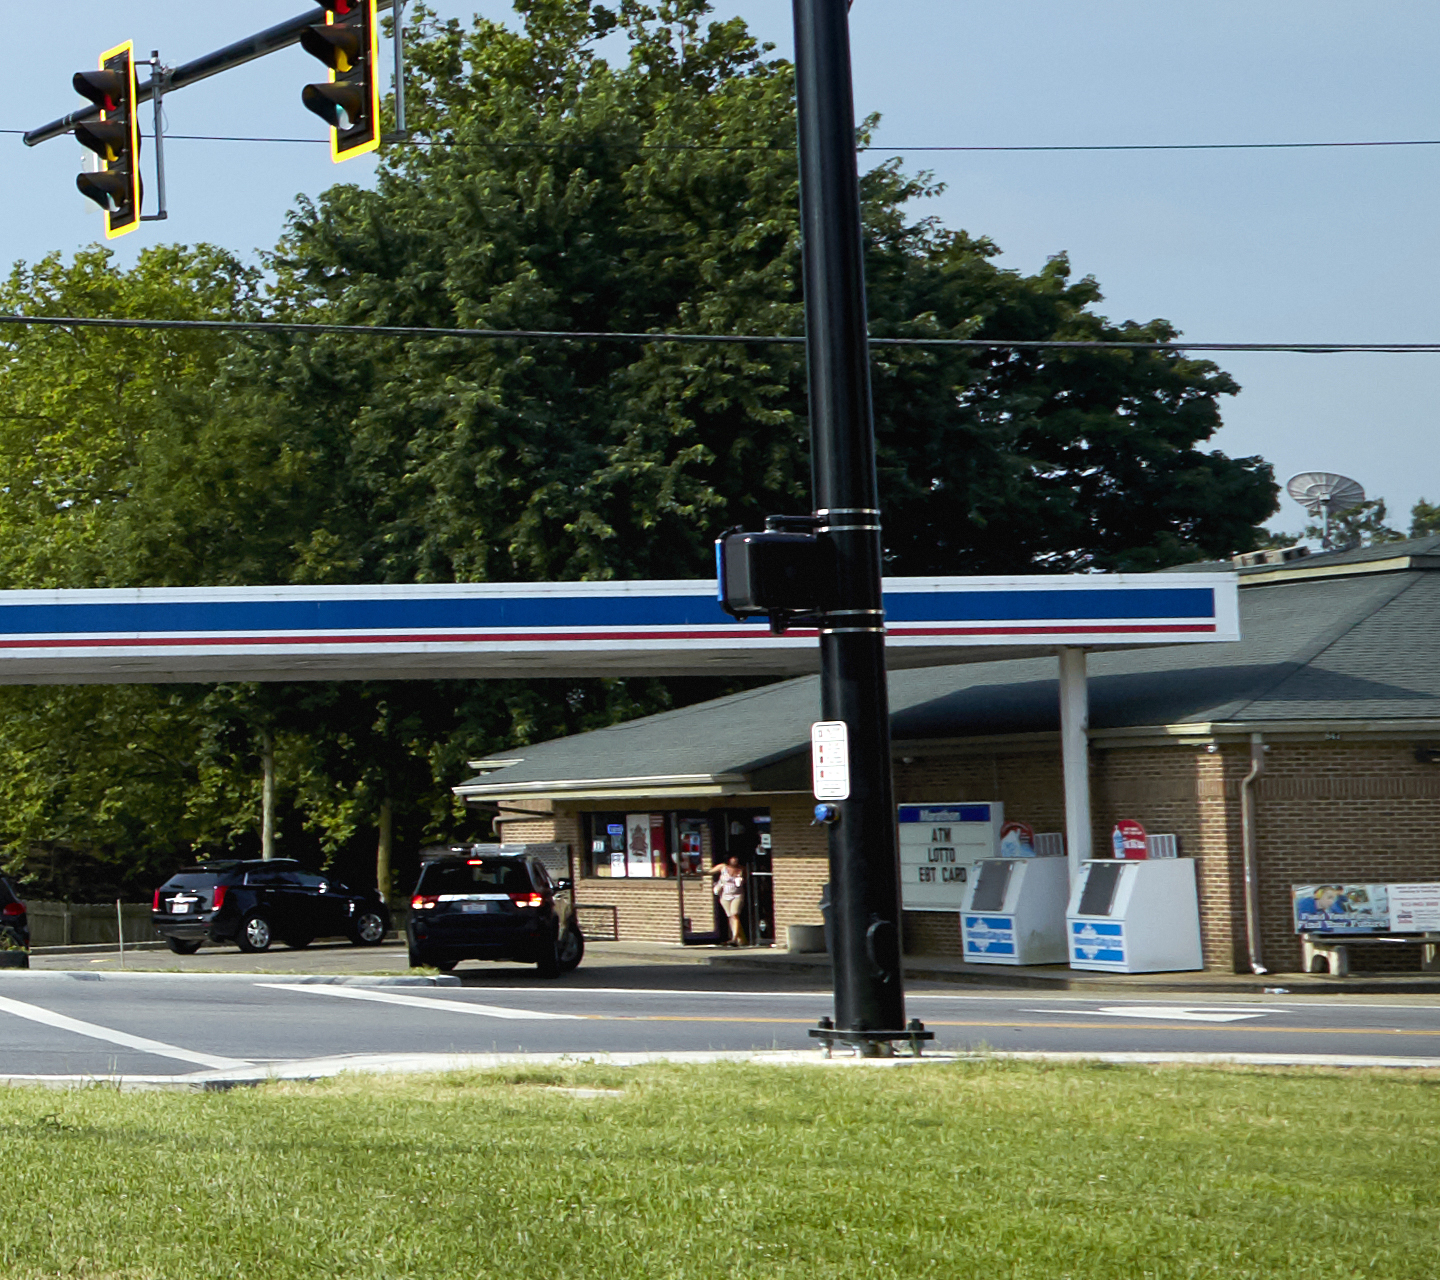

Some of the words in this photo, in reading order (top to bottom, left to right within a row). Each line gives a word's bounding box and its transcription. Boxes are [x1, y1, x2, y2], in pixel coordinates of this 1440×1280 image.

[931, 827, 952, 842] ATM
[927, 847, 956, 863] LOTTO
[918, 867, 936, 883] EBT
[941, 867, 967, 883] CARD
